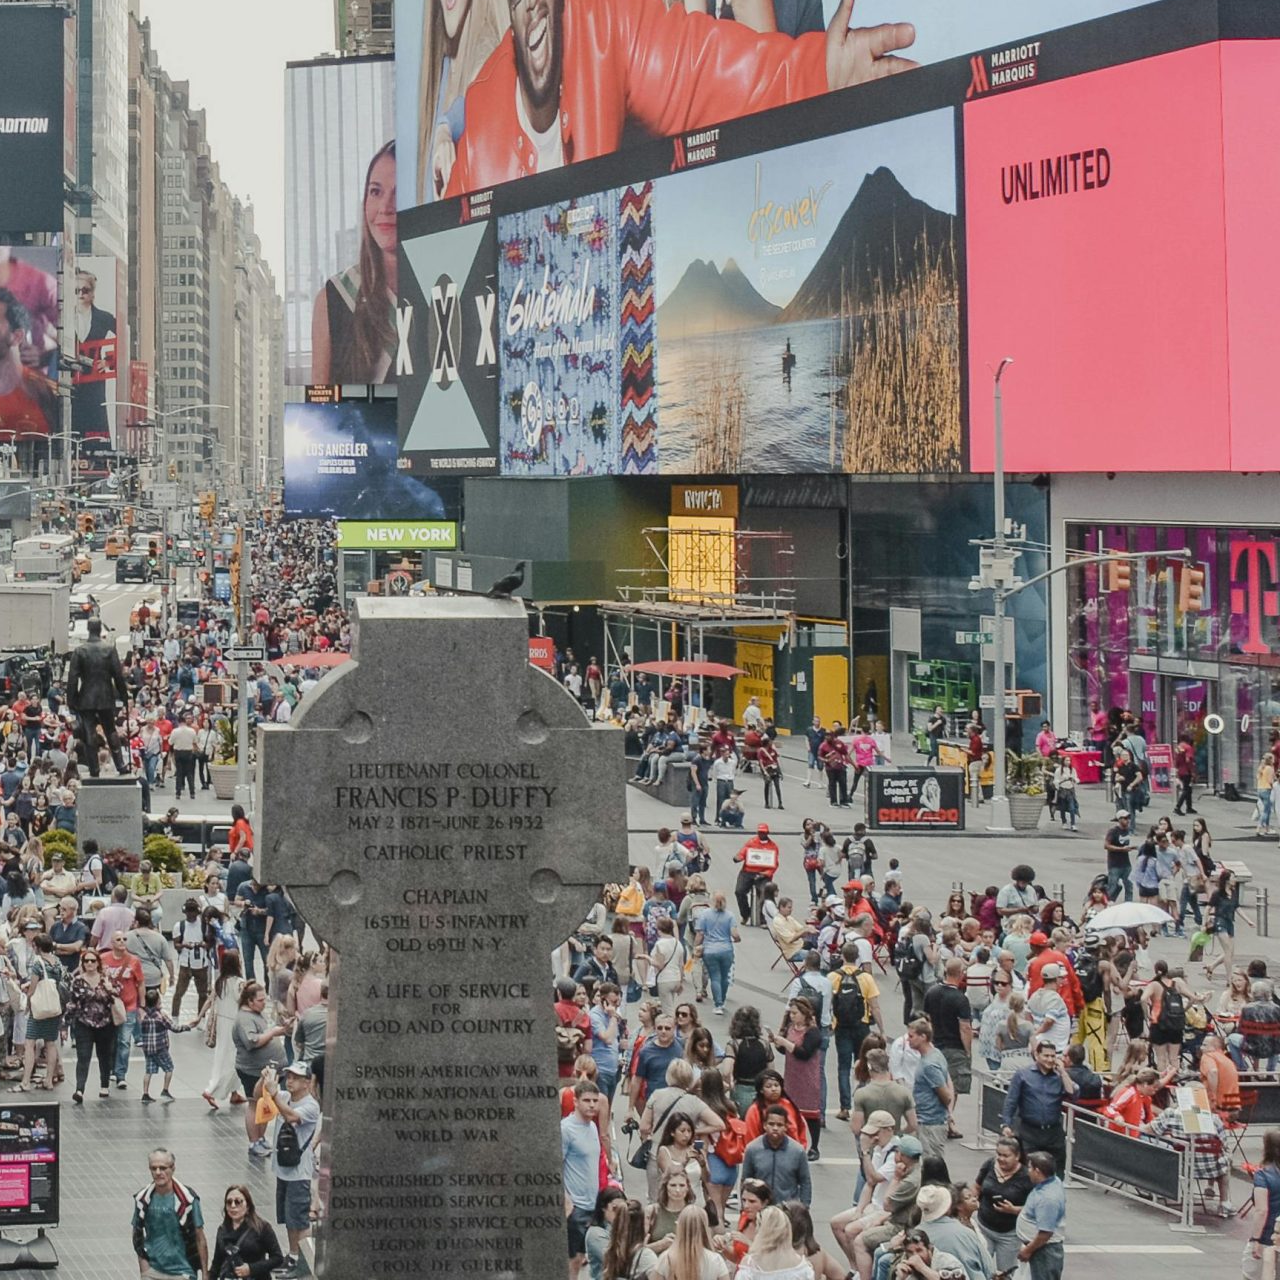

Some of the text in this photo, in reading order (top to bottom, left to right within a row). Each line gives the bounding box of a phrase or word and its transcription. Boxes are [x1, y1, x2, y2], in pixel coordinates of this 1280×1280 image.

[991, 42, 1041, 67] MARRIOTT
[991, 63, 1035, 86] MARQUIS
[687, 129, 719, 147] MARRIOTT
[687, 146, 716, 163] MARQUIS
[1001, 147, 1110, 205] UNLIMITED
[470, 191, 493, 204] MARRIOTT
[470, 204, 491, 217] MARQUIS
[506, 258, 595, 336] Guatemala
[366, 528, 451, 541] NEW YORK
[975, 634, 986, 643] 46
[1149, 754, 1170, 766] FREE
[349, 763, 540, 779] LIEUTENANT COLONEL
[335, 787, 558, 808] FRANCIS DUFFY
[348, 815, 544, 830] MAY 2 26 1932
[364, 845, 527, 861] CATHOLIC PRIEST
[403, 889, 488, 905] CHAPLAIN
[364, 915, 410, 929] 165TH
[386, 938, 466, 952] OLD 69TH
[367, 983, 530, 998] A LIFE OF SERVICE
[431, 1003, 461, 1016] FOR
[359, 1019, 535, 1034] GOD AND COUNTRY
[355, 1064, 539, 1079] SPANISH AMERICAN WAR
[335, 1085, 558, 1101] NEW YORK NATIONAL GUARD
[378, 1107, 516, 1121] MEXICAN BORDER
[395, 1129, 499, 1142] WORLD WAR
[332, 1173, 561, 1189] DISTINGUISHED SERVICE CROSS
[332, 1195, 564, 1209] DISTINGUISHED SERVICE MEDAL
[332, 1216, 561, 1231] CONSPICUOUS SERVICE CROSS
[372, 1238, 424, 1251] LEGION
